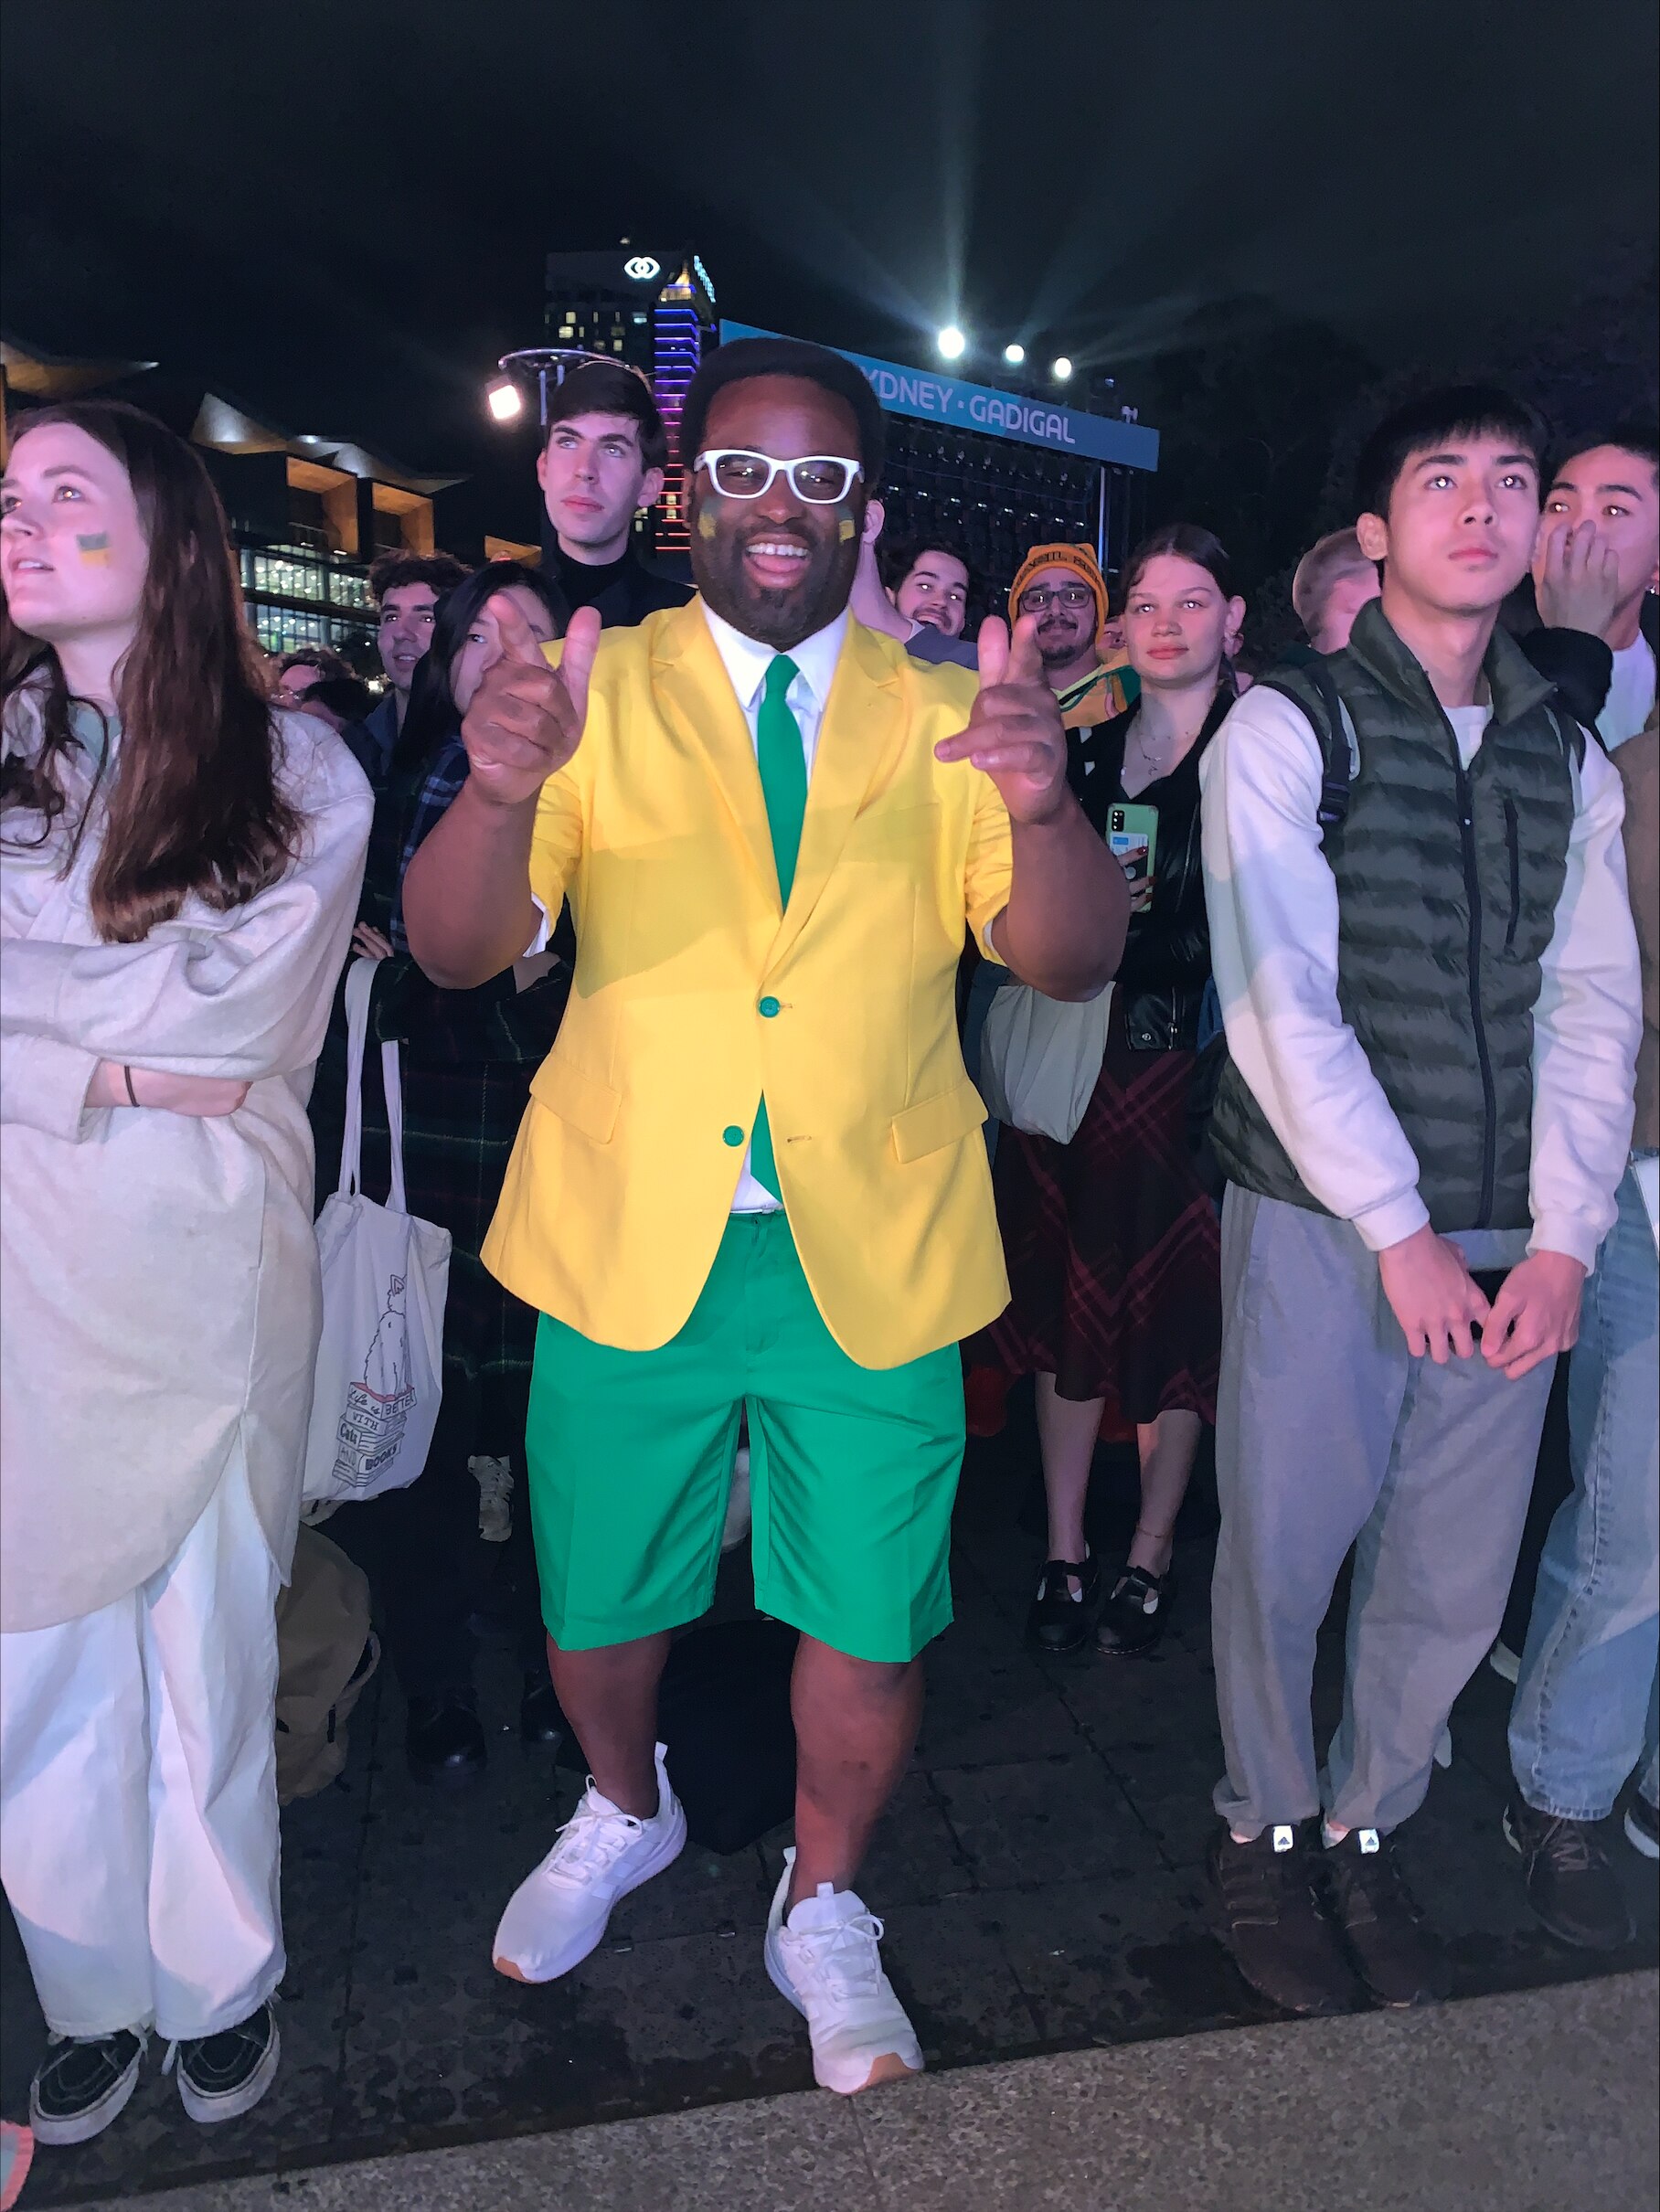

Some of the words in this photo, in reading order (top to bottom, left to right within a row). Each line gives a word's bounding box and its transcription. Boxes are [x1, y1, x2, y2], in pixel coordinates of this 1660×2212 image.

[860, 367, 953, 413] YDNEY
[969, 395, 1076, 444] GADIGAL
[370, 1406, 380, 1415] is
[340, 1422, 357, 1445] Cats
